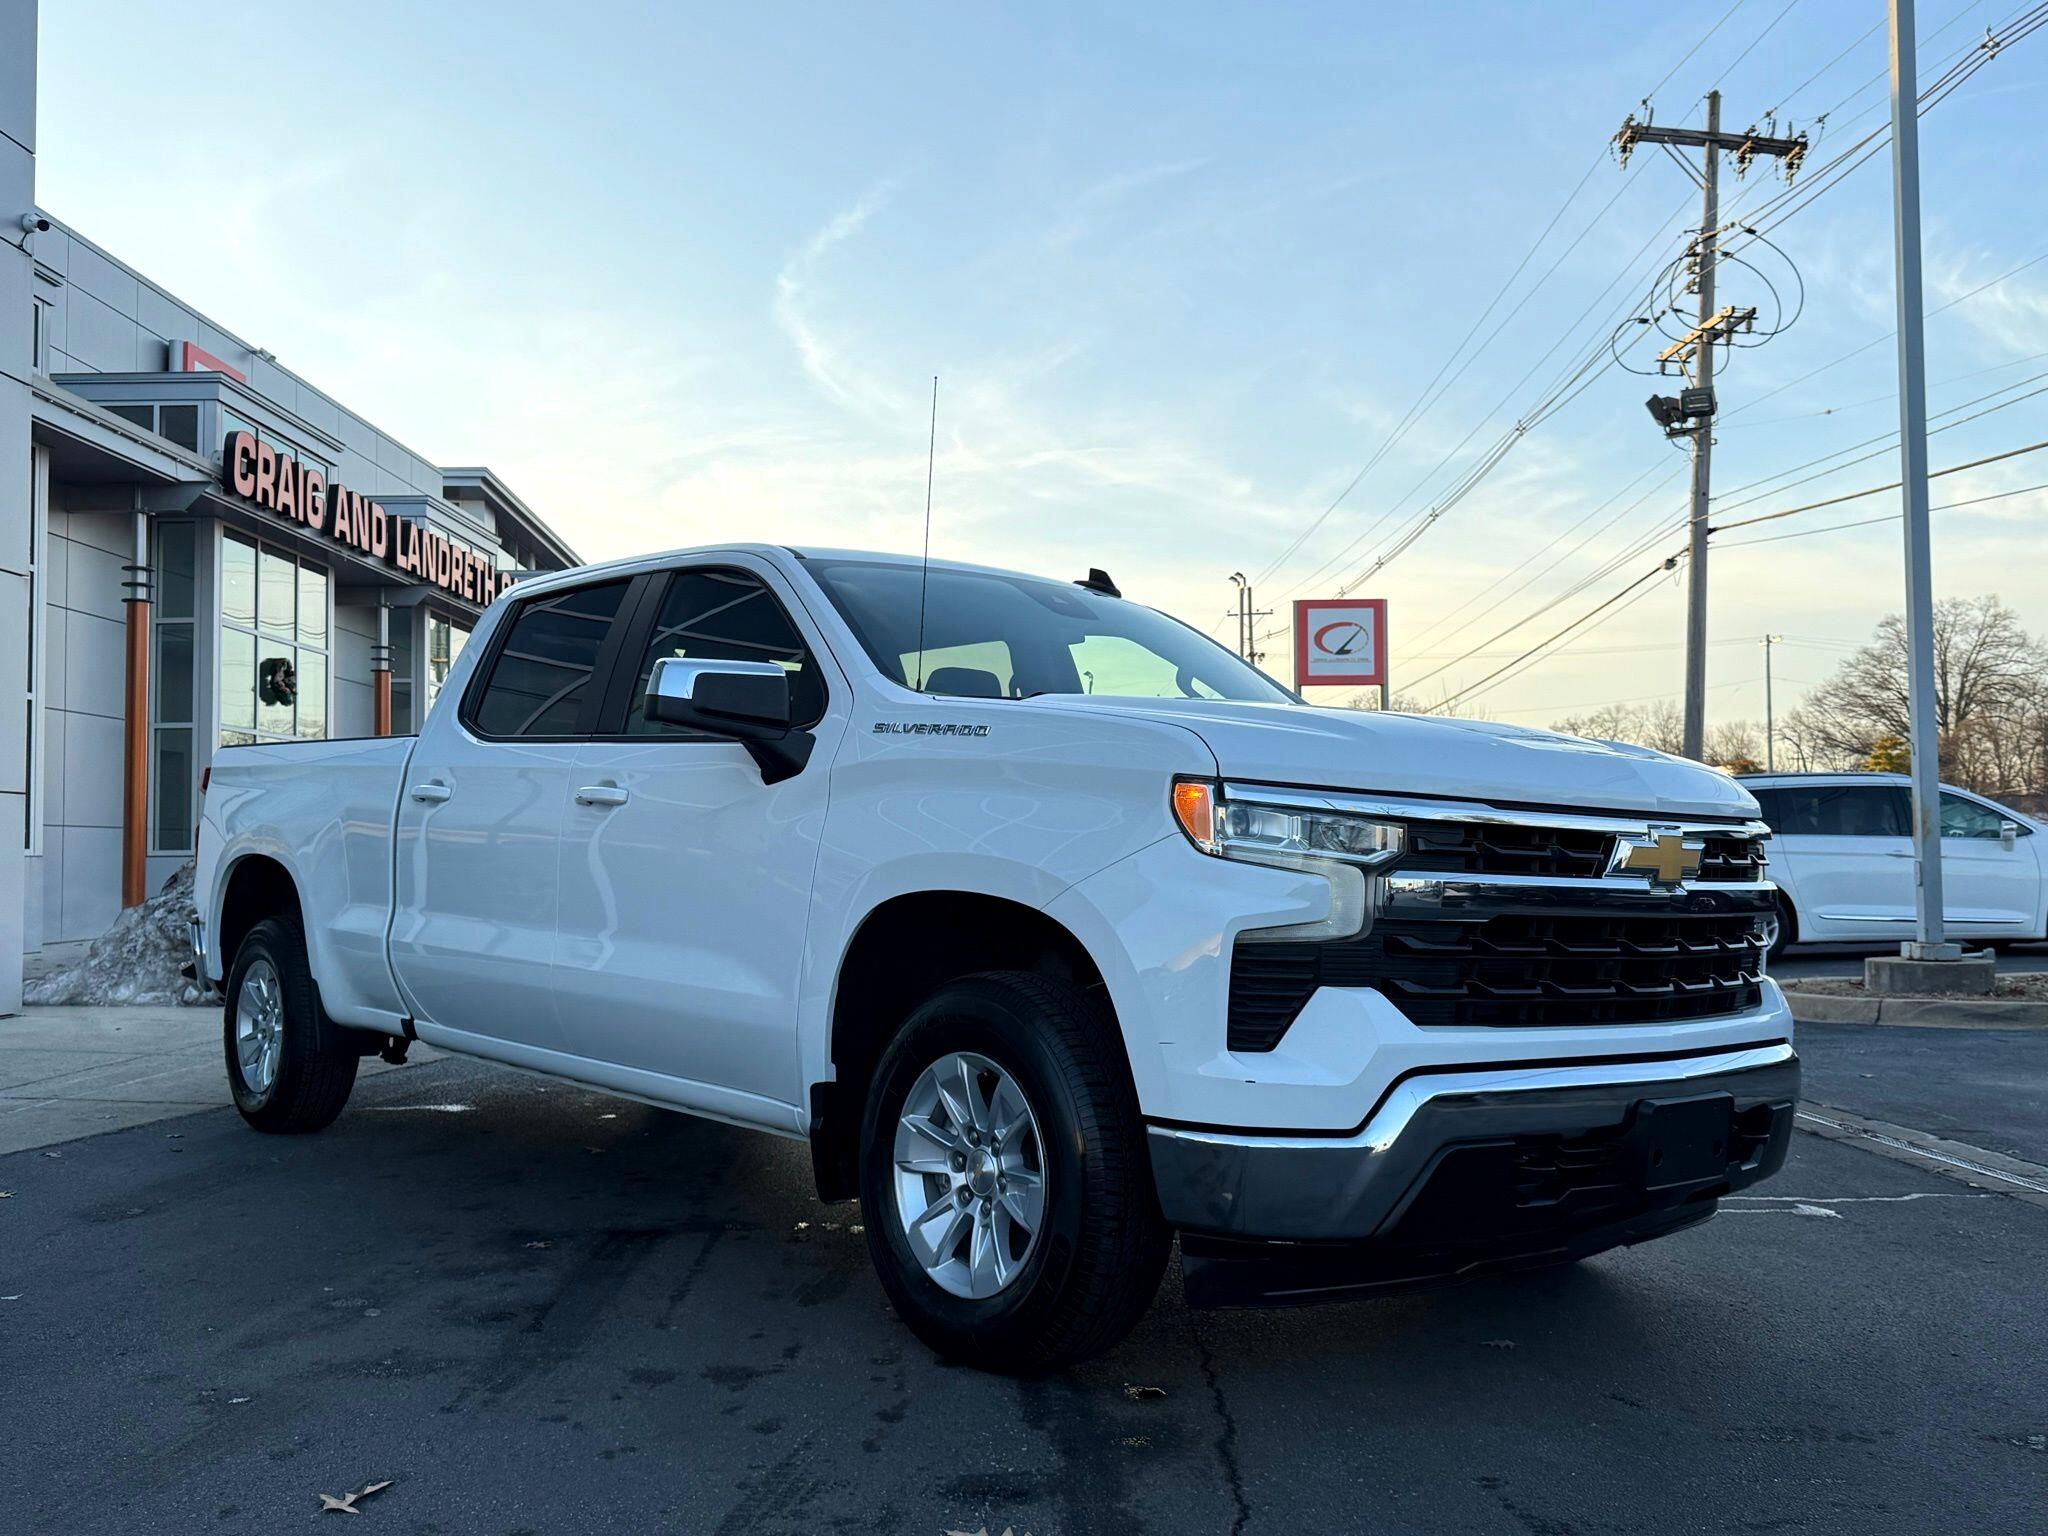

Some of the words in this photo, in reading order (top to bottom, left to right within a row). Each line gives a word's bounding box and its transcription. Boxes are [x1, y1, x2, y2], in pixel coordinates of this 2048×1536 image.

[229, 430, 325, 529] CRAIG
[332, 484, 388, 559] AND
[394, 515, 496, 607] LANDRETH
[873, 722, 991, 737] SILVERADO
